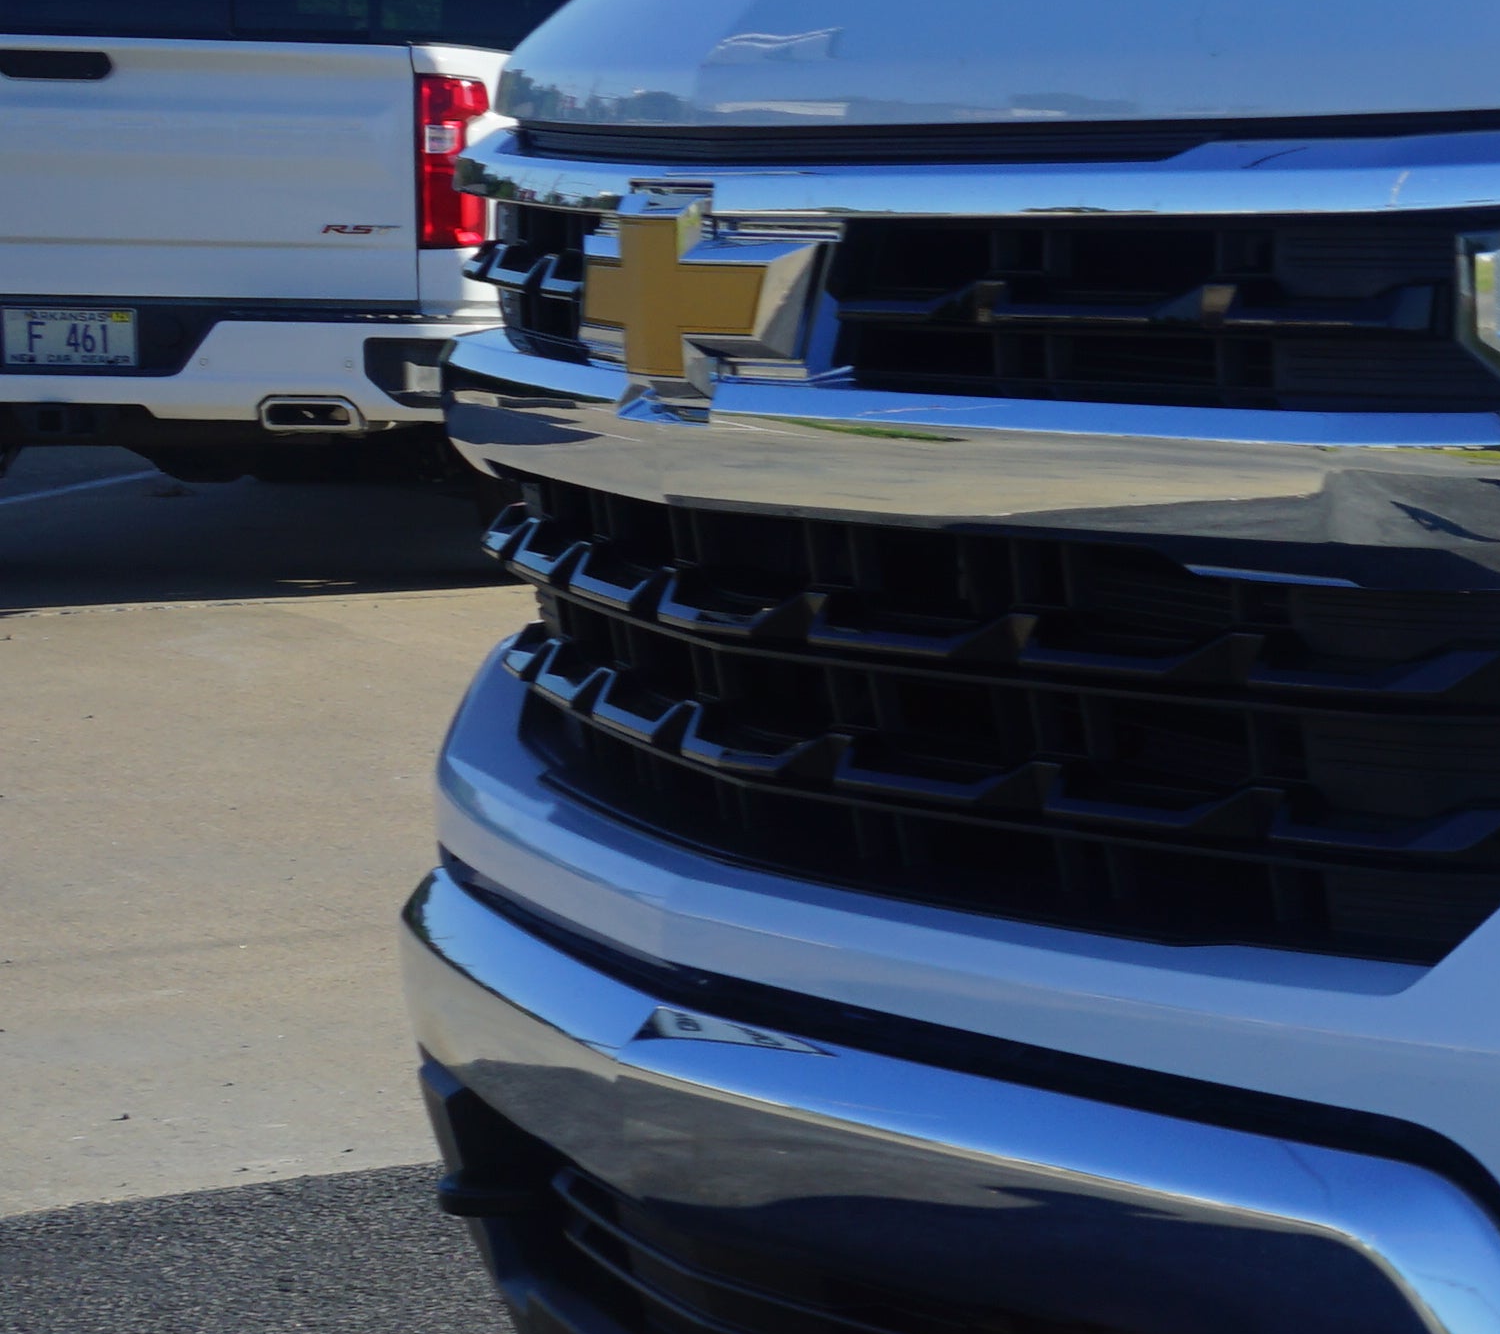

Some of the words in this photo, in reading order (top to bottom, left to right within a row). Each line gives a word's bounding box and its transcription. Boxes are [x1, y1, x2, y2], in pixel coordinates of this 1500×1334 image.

[321, 224, 402, 235] RST
[30, 311, 108, 322] ARKANSAS
[27, 320, 46, 354] F
[65, 322, 109, 354] 461
